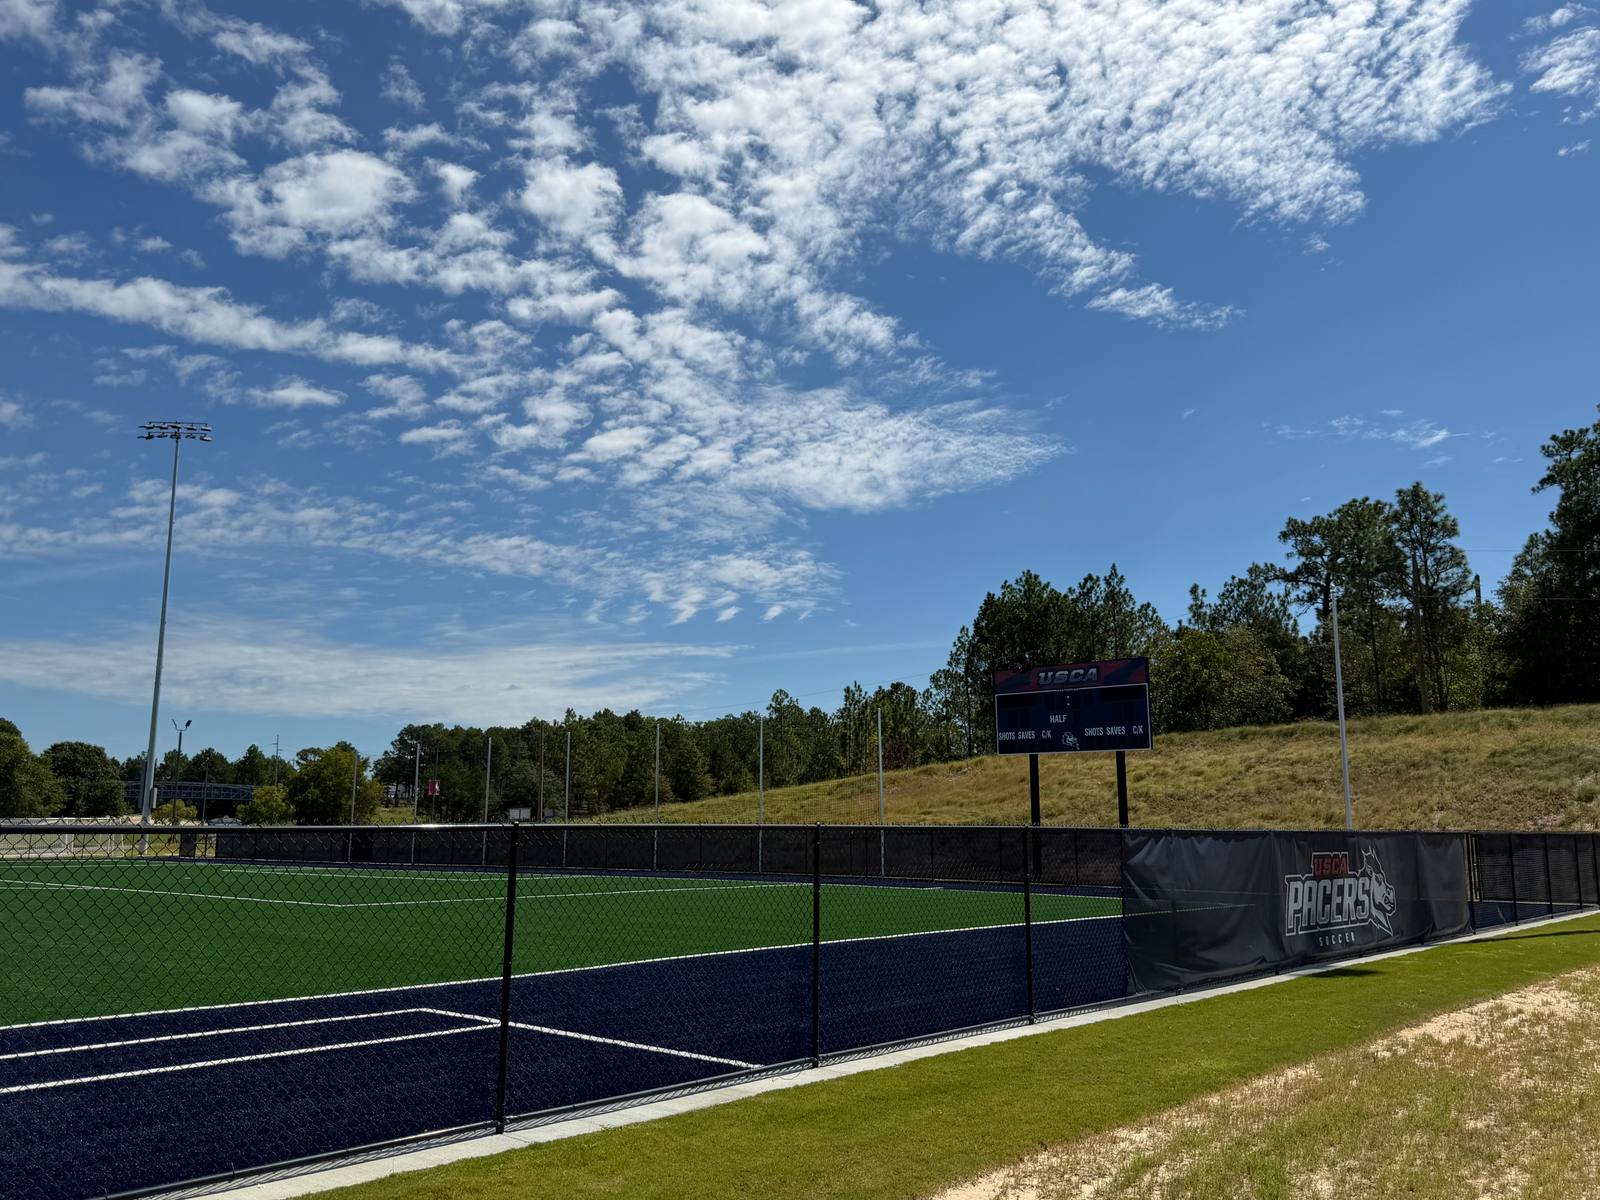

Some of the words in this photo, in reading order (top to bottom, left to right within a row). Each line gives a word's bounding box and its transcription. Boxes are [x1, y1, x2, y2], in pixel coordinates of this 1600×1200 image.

[1038, 668, 1098, 685] USCA
[1050, 714, 1067, 723] HALF
[999, 732, 1016, 741] SHOTS
[1018, 730, 1036, 739] SAVES
[1042, 729, 1052, 738] C/K
[1085, 727, 1104, 737] SHOTS
[1106, 726, 1126, 735] SAVES
[1133, 725, 1144, 734] C/K
[1313, 858, 1347, 876] USCA
[1287, 878, 1370, 929] PACERS
[1319, 932, 1355, 946] SOCCER
